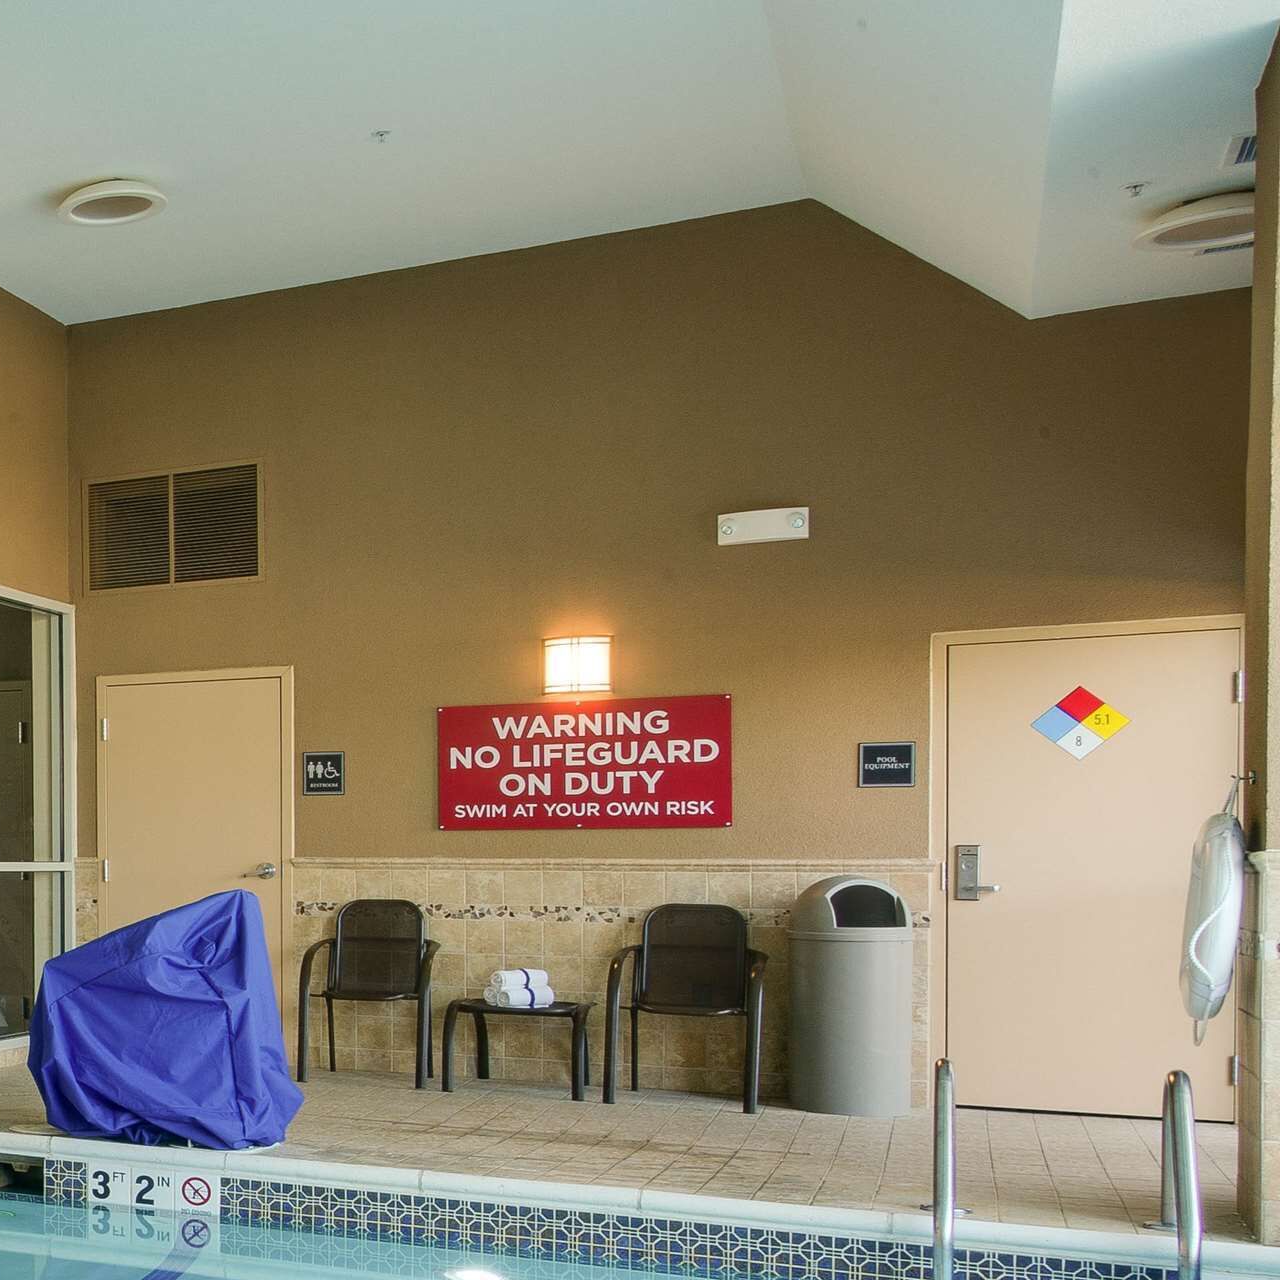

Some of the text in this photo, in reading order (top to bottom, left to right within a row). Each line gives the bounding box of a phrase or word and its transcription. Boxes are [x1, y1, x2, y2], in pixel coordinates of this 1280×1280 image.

[492, 710, 670, 740] WARNING
[1093, 713, 1111, 727] 5.1
[449, 739, 720, 769] NO LIFEGUARD
[1075, 735, 1083, 748] 8
[499, 770, 665, 797] ON DUTY
[454, 800, 715, 818] SWIM AT YOUR OWN RISK
[92, 1170, 170, 1205] 3 FT 2 IN
